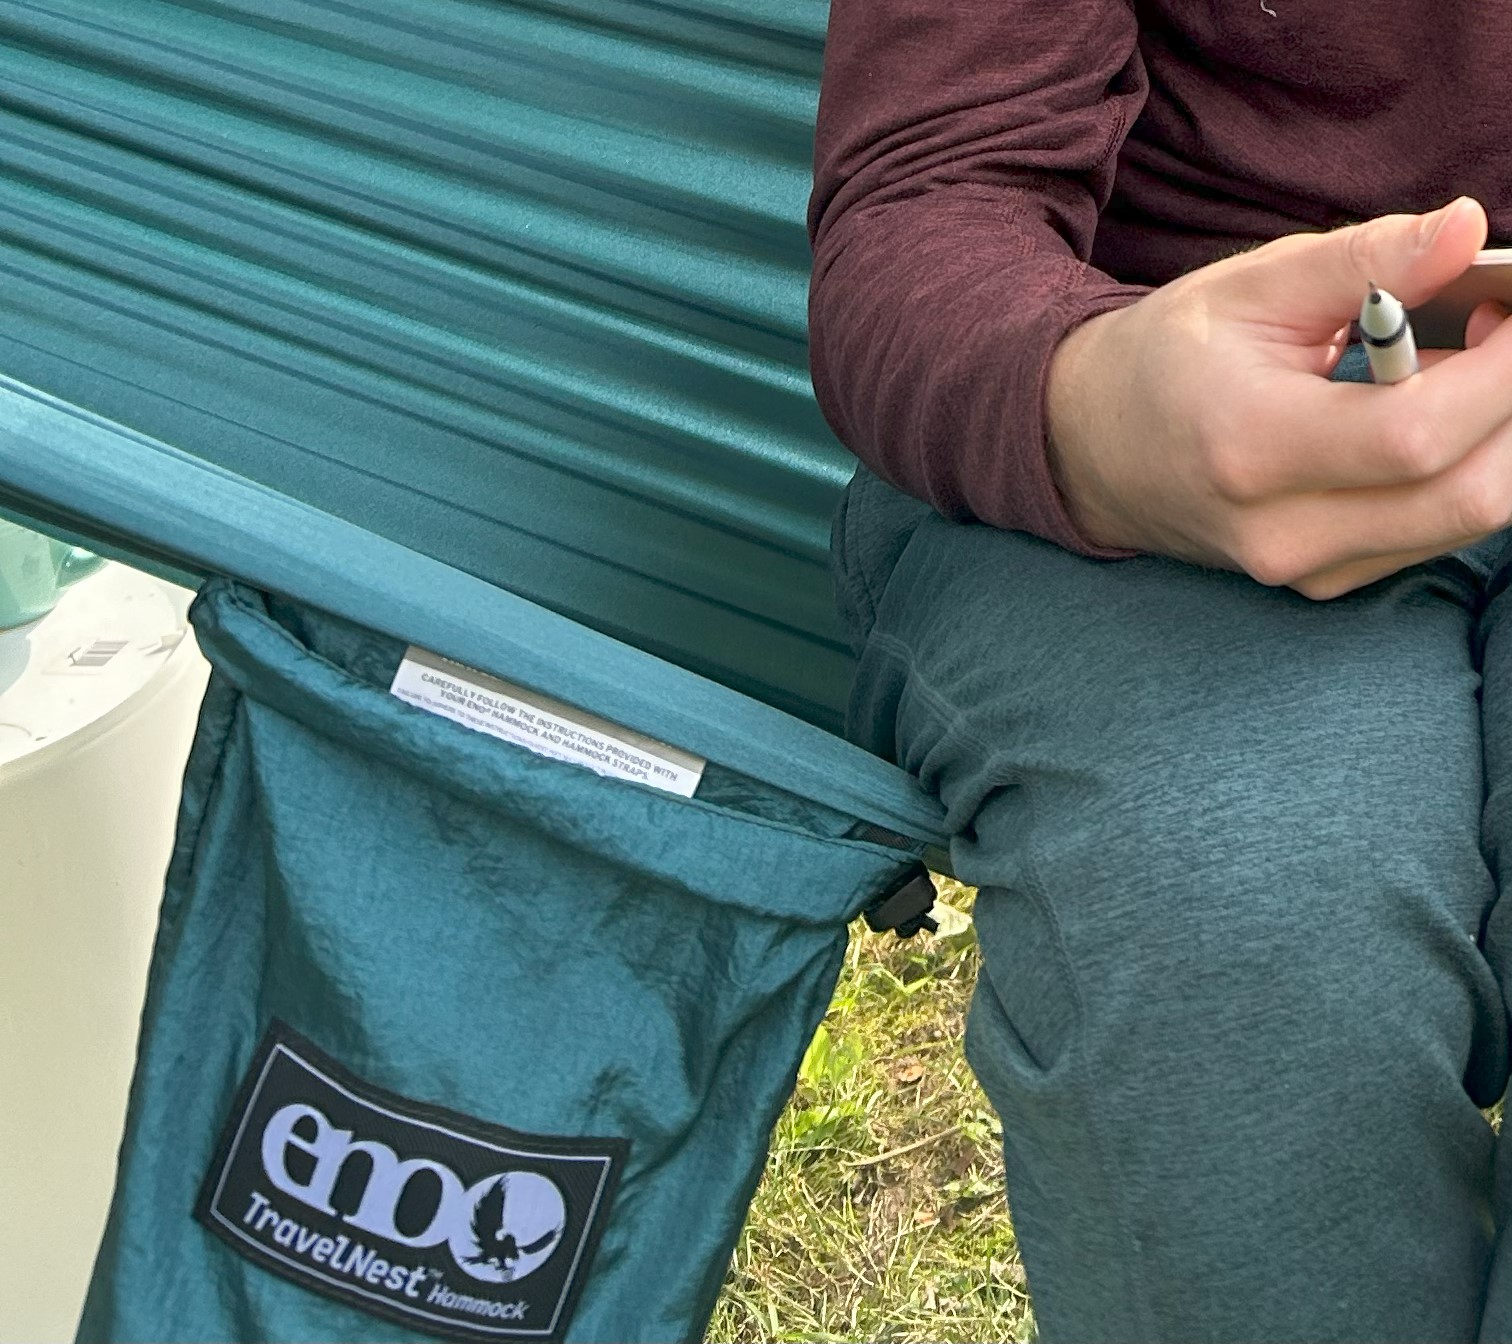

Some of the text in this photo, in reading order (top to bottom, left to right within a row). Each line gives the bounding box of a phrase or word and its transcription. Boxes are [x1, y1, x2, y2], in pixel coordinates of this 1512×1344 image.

[421, 673, 475, 699] CAREFULLY
[476, 694, 517, 714] FOLLOW
[519, 709, 536, 723] THE
[536, 717, 605, 750] INSTRUCTIONS
[605, 743, 652, 770] PROVIDED
[653, 764, 679, 782] WITH
[440, 689, 466, 706] YOUR
[492, 710, 539, 736] HAMMOCK
[541, 730, 561, 744] AND
[562, 738, 611, 765] HAMMOCK
[426, 1283, 530, 1320] Hammock
